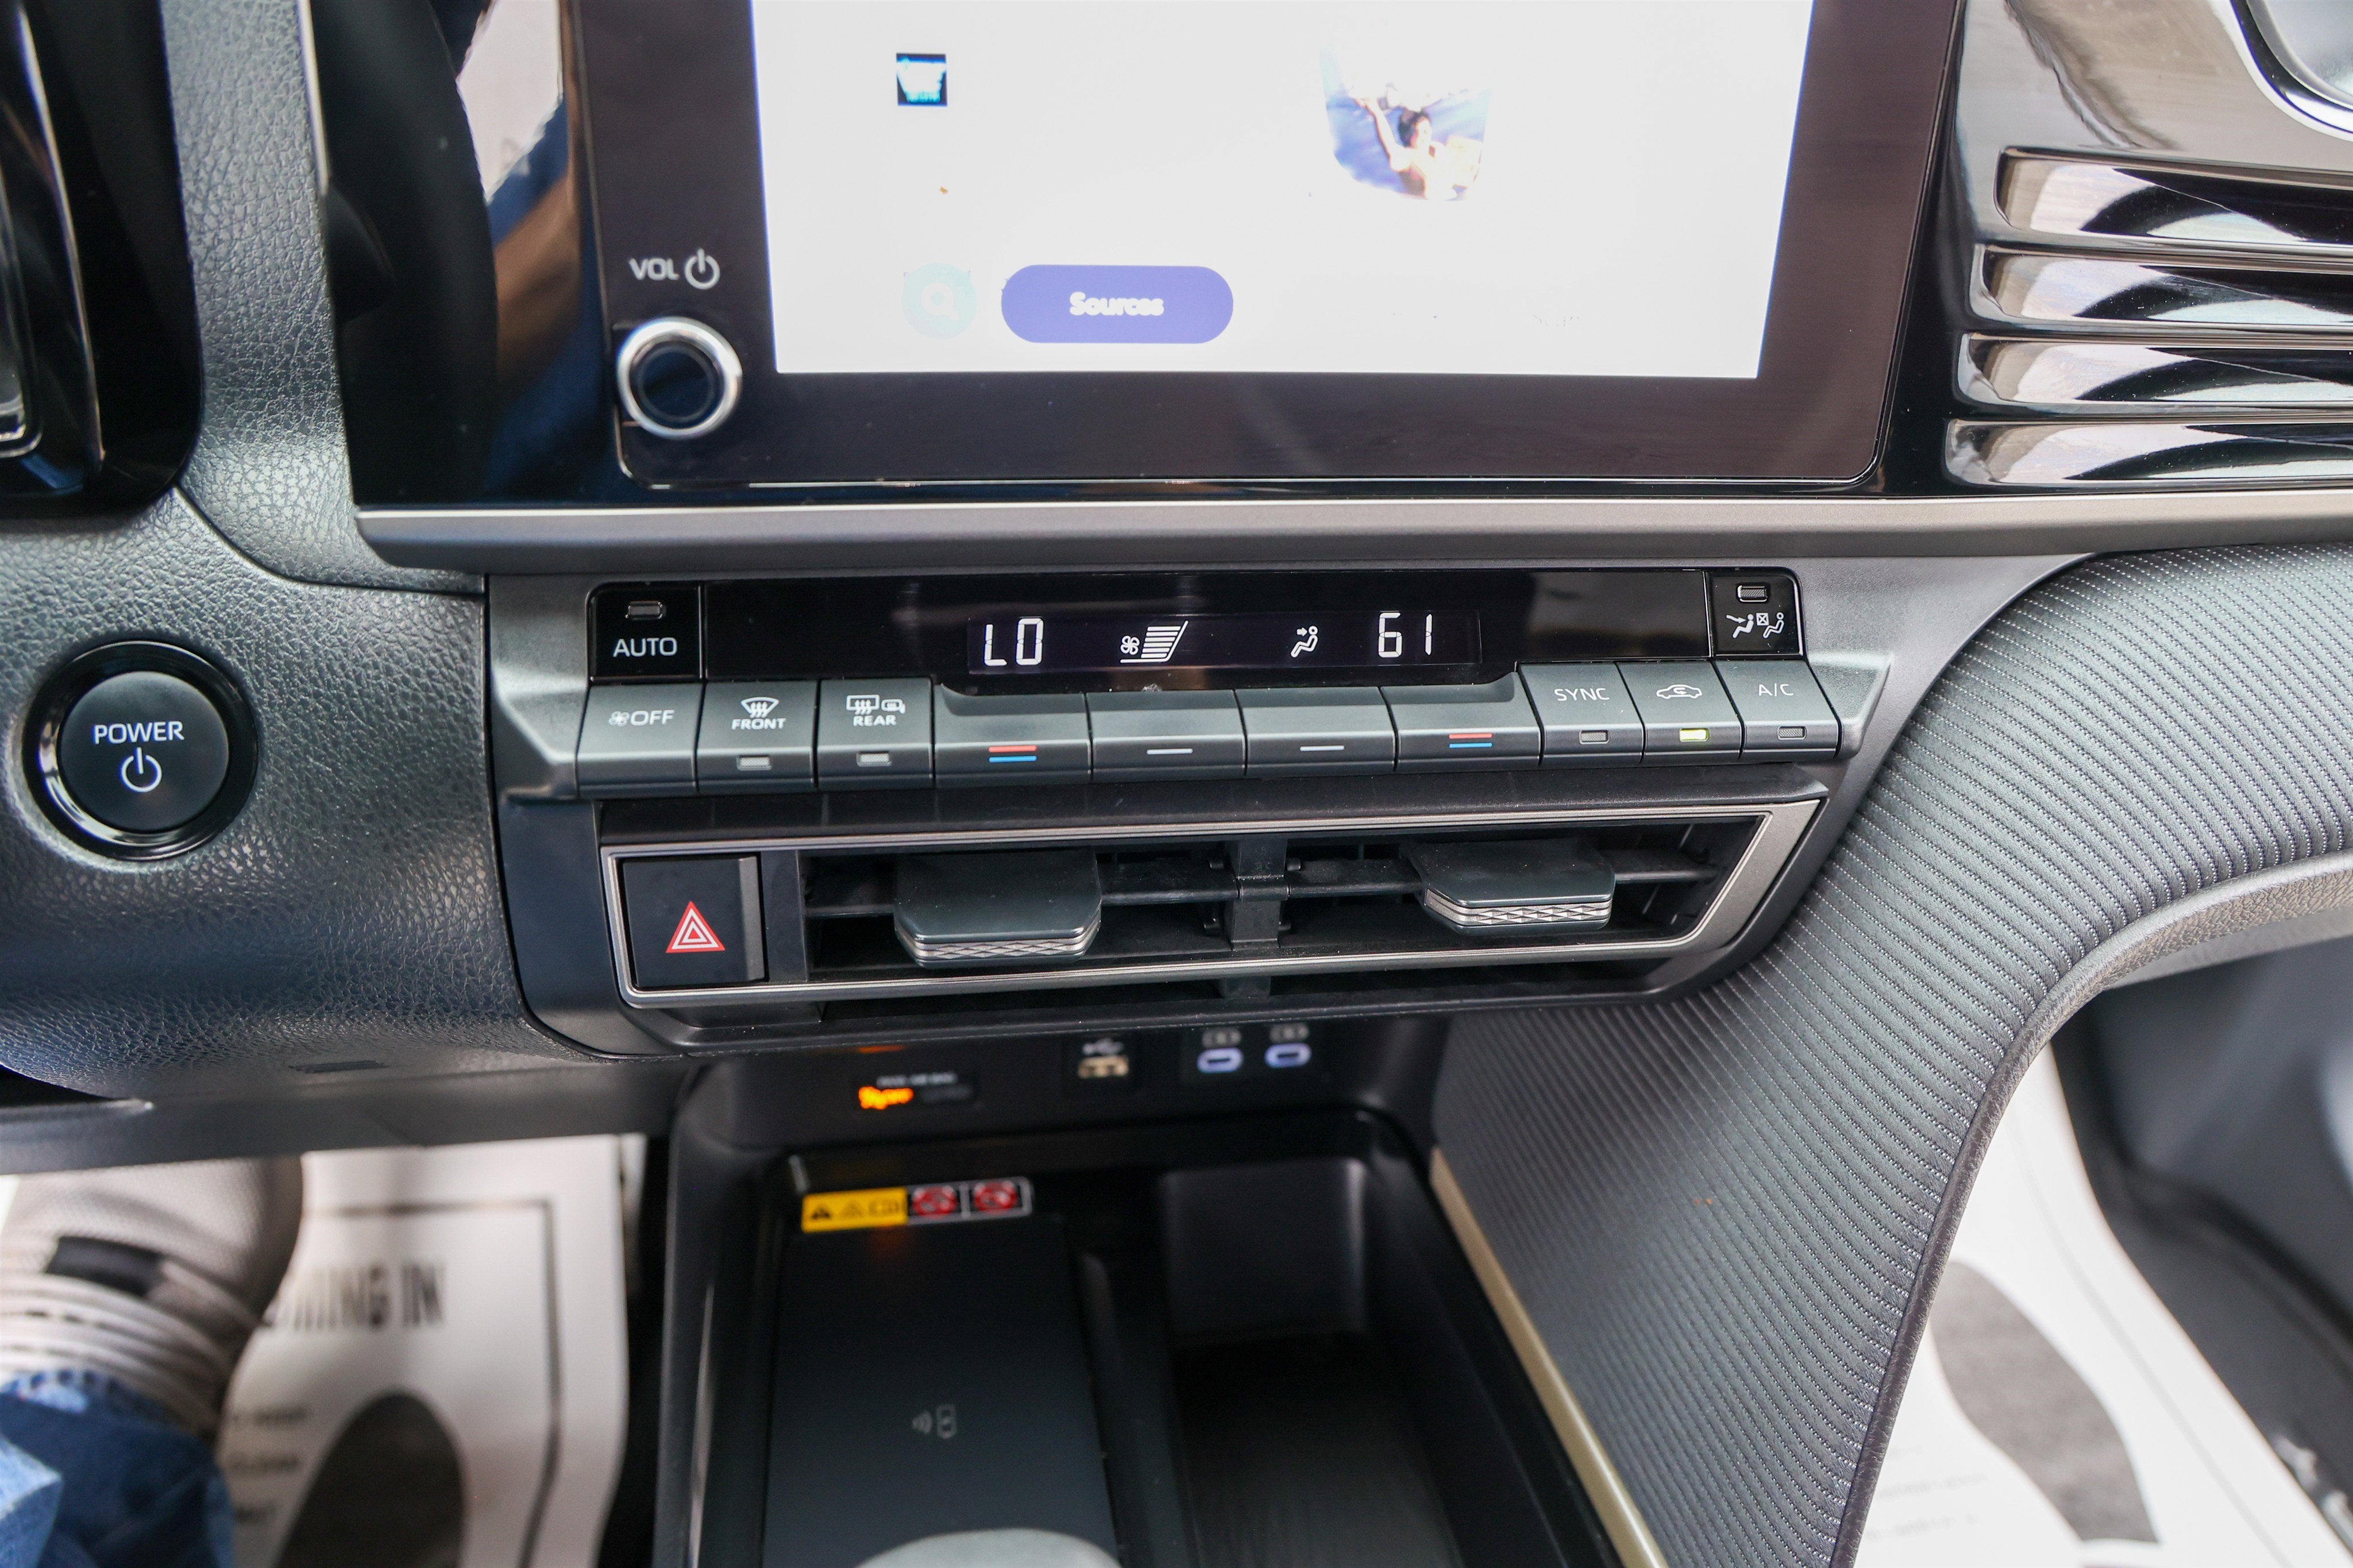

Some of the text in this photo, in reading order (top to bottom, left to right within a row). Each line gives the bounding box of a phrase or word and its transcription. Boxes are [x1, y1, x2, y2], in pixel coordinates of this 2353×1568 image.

[629, 258, 680, 280] VOL
[1070, 291, 1164, 316] Sources
[984, 618, 1044, 666] LO
[1379, 612, 1432, 658] 61
[613, 637, 678, 657] AUTO
[1554, 688, 1610, 701] SYNC
[1758, 682, 1794, 697] A/C
[630, 709, 675, 726] OFF
[731, 718, 786, 730] FRONT
[853, 715, 897, 727] REAR
[94, 720, 185, 745] POWER
